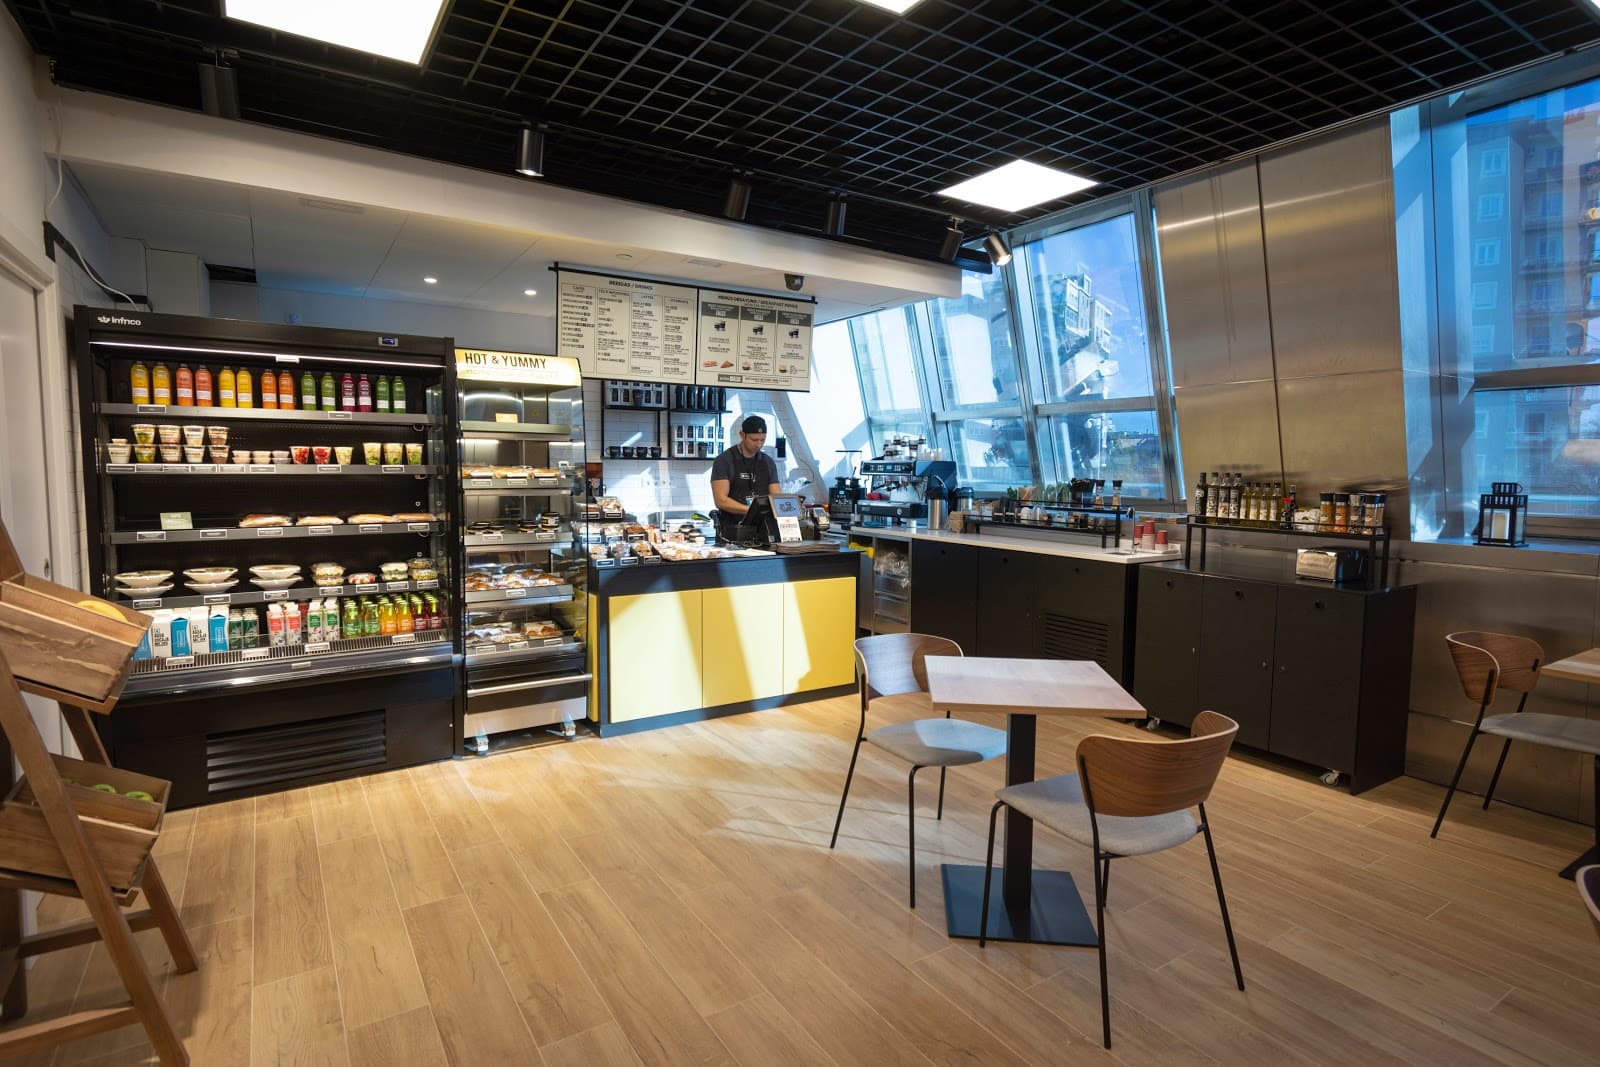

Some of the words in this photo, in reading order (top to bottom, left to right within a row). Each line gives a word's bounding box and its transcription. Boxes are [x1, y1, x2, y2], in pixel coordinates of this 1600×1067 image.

[609, 280, 631, 288] BEBIDAS
[111, 316, 142, 326] infrico
[464, 352, 487, 365] HOT
[492, 355, 499, 365] &
[501, 355, 547, 369] YUMMY
